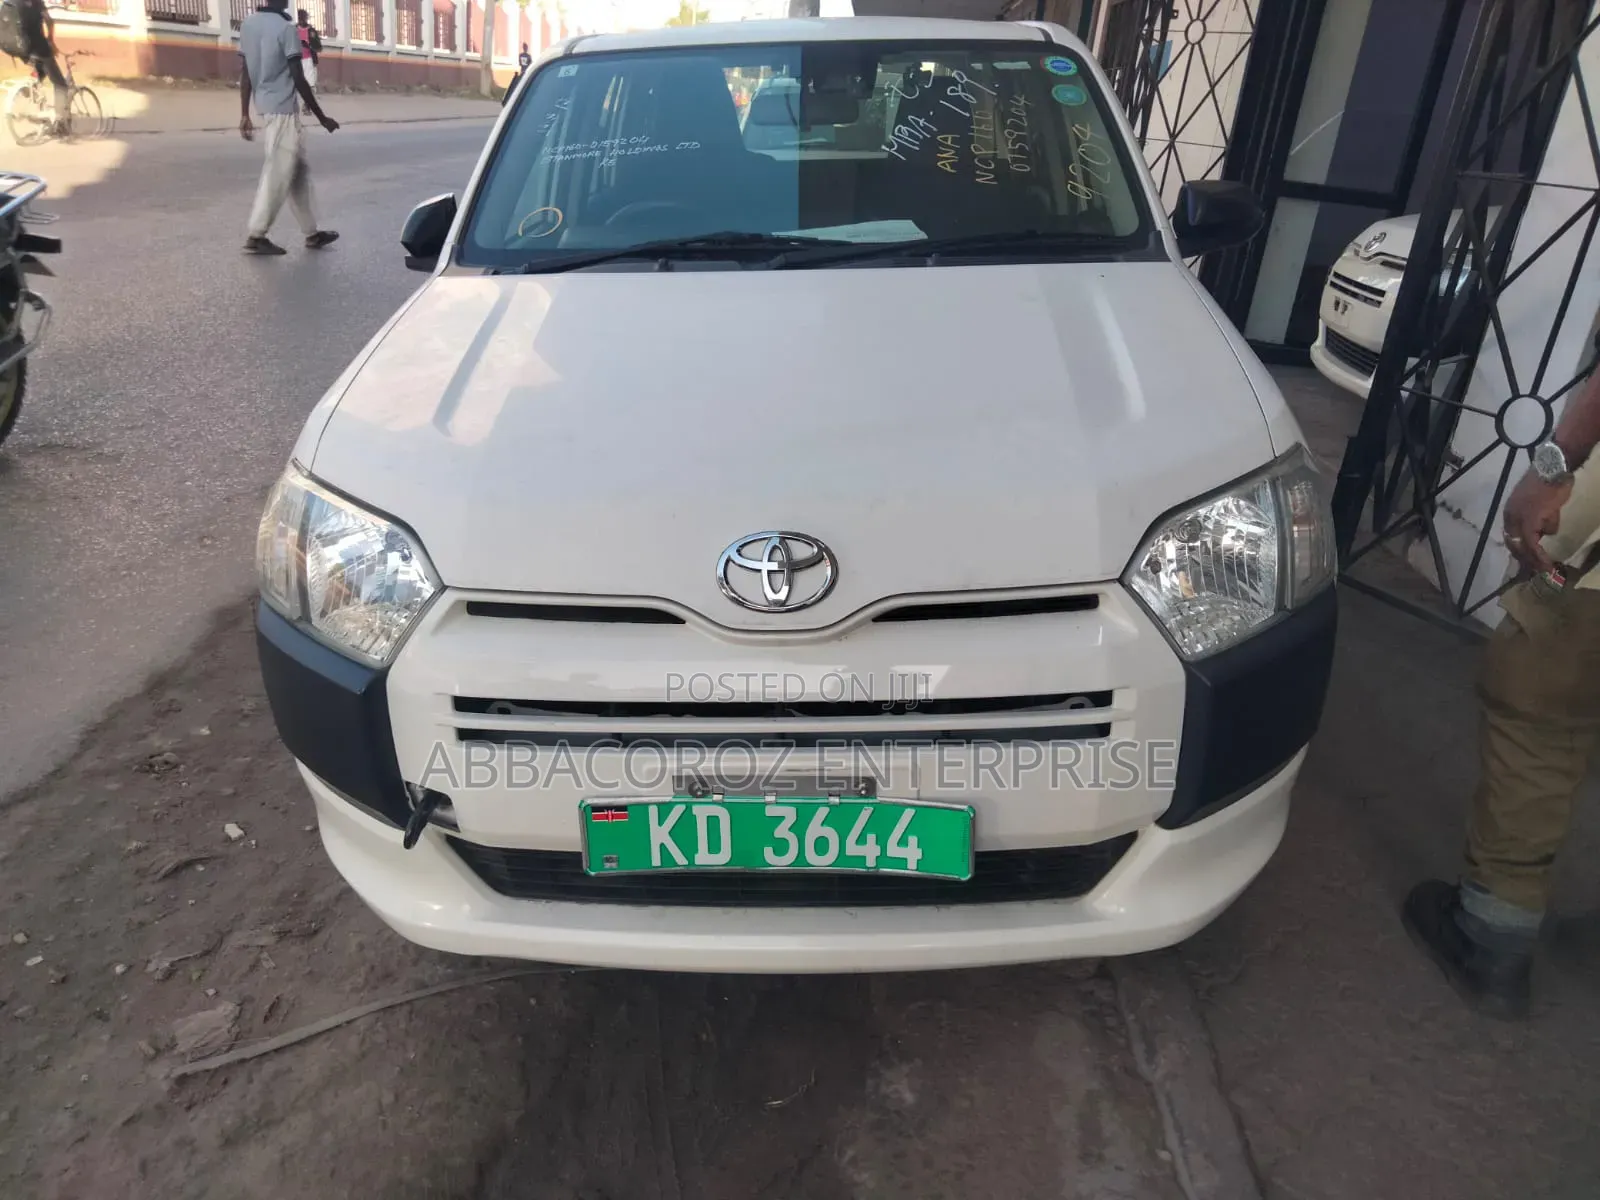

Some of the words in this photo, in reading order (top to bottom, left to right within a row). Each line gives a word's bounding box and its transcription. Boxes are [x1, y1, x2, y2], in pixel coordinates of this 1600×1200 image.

[937, 134, 961, 173] ANA
[648, 804, 732, 867] KD
[763, 805, 923, 870] 3644
